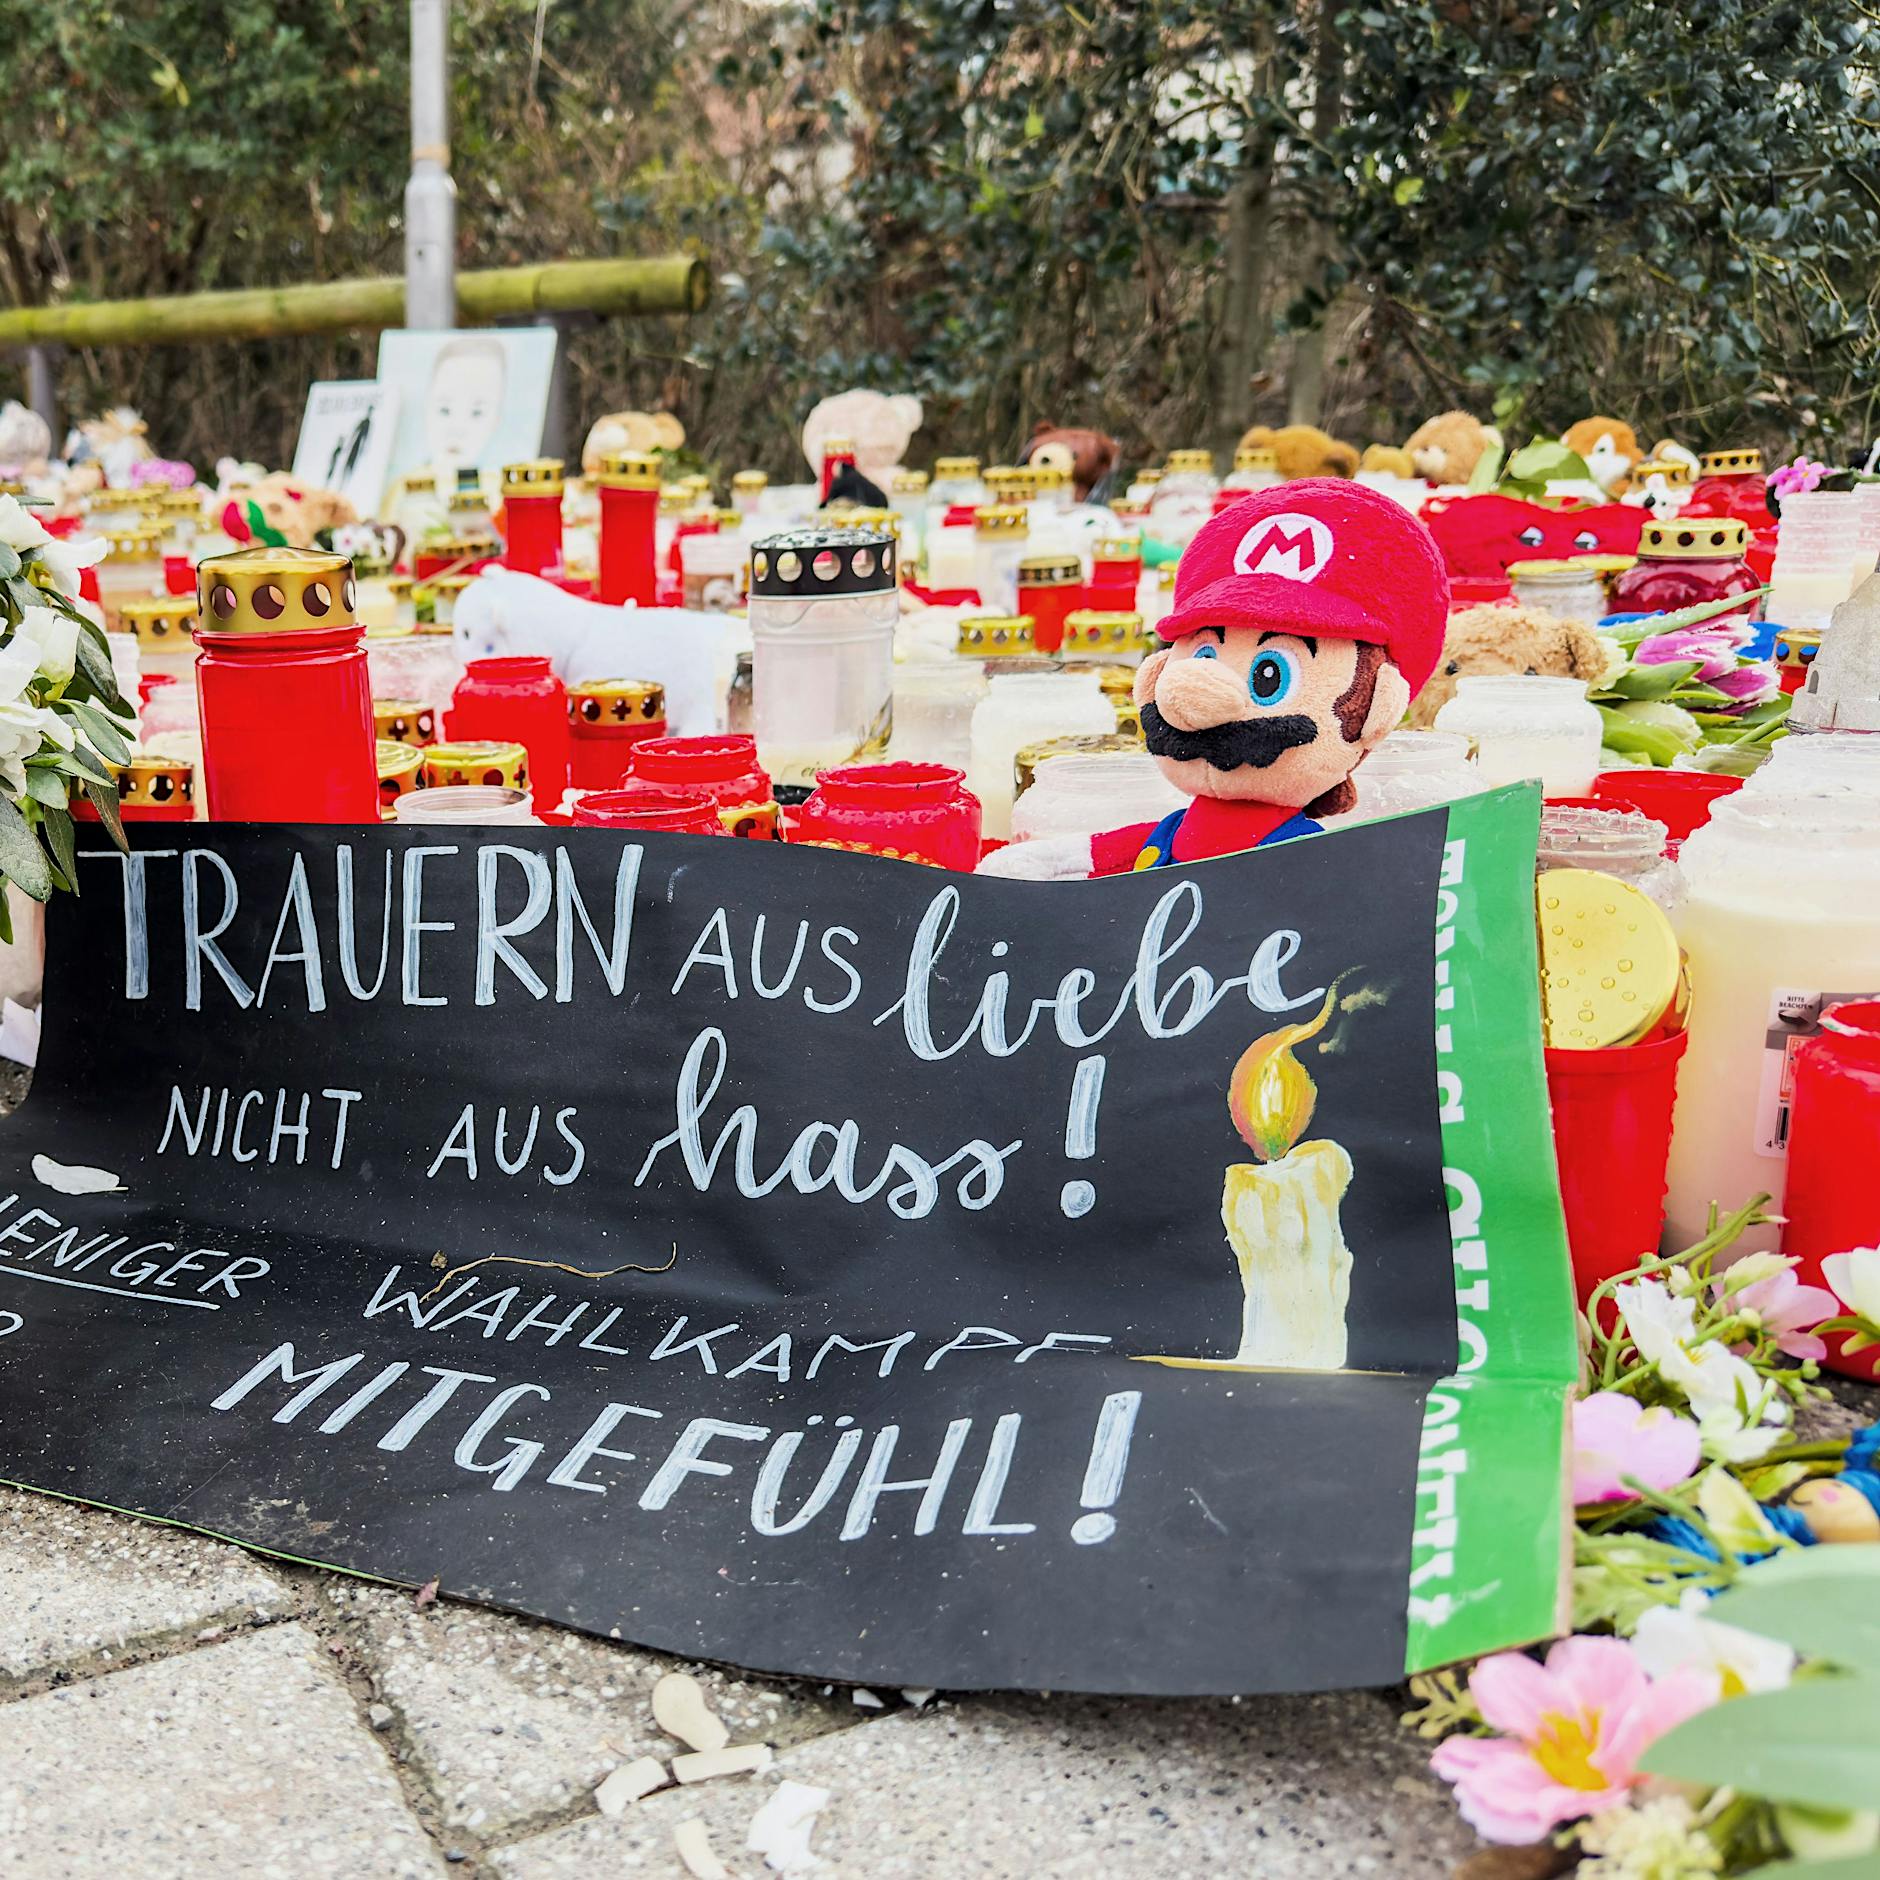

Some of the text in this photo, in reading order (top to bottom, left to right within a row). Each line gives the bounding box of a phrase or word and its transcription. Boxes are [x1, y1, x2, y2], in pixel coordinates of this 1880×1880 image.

[1244, 522, 1315, 572] M
[77, 844, 643, 1012] TRAUERN
[672, 908, 861, 1013] AUS
[873, 880, 1325, 1061] liebe
[157, 1086, 362, 1170] NICHT
[427, 1104, 585, 1186] AUS
[0, 1194, 270, 1298] ENIGER
